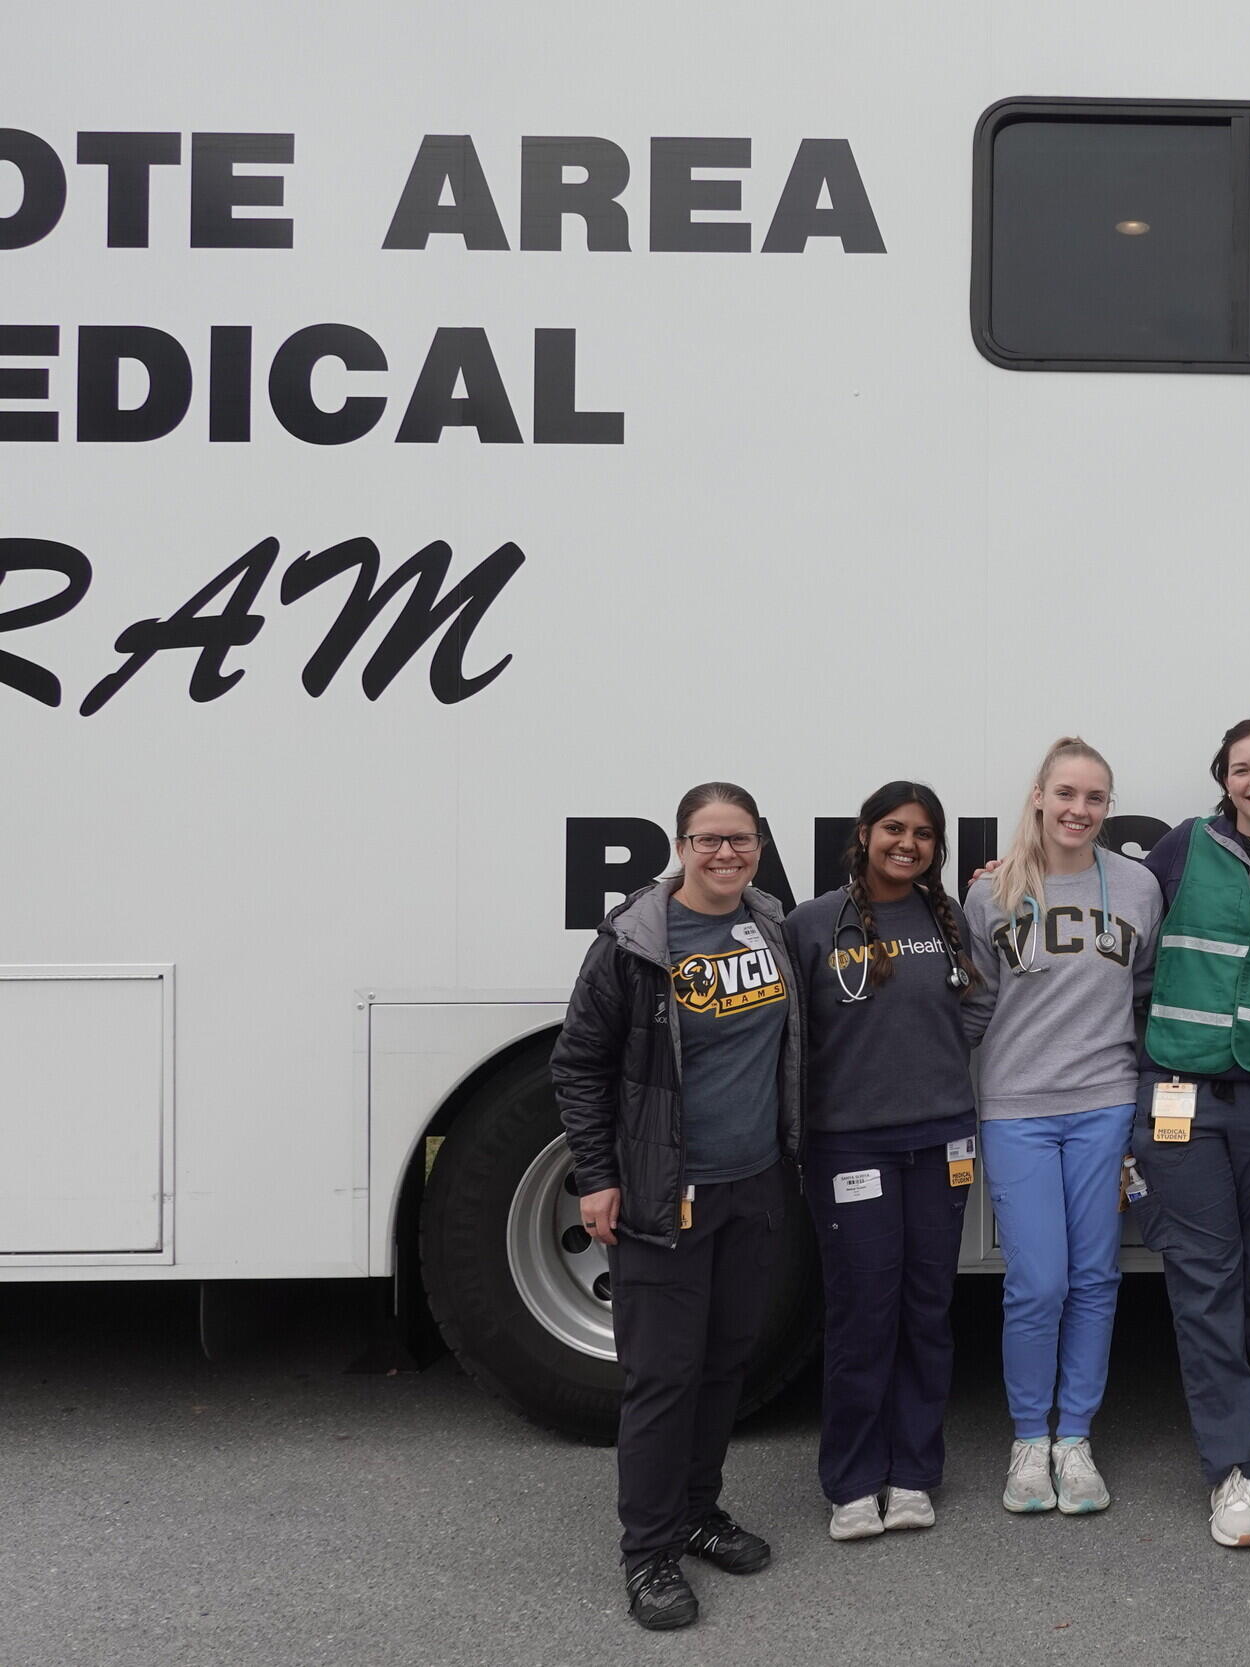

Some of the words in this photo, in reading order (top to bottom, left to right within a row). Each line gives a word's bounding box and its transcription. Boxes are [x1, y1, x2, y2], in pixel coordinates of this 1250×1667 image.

[381, 134, 888, 254] AREA
[993, 905, 1137, 968] VCU
[717, 949, 779, 994] VCU
[726, 986, 780, 1007] RAMS
[952, 1171, 971, 1179] MEDICAL
[952, 1176, 972, 1185] STUDENT
